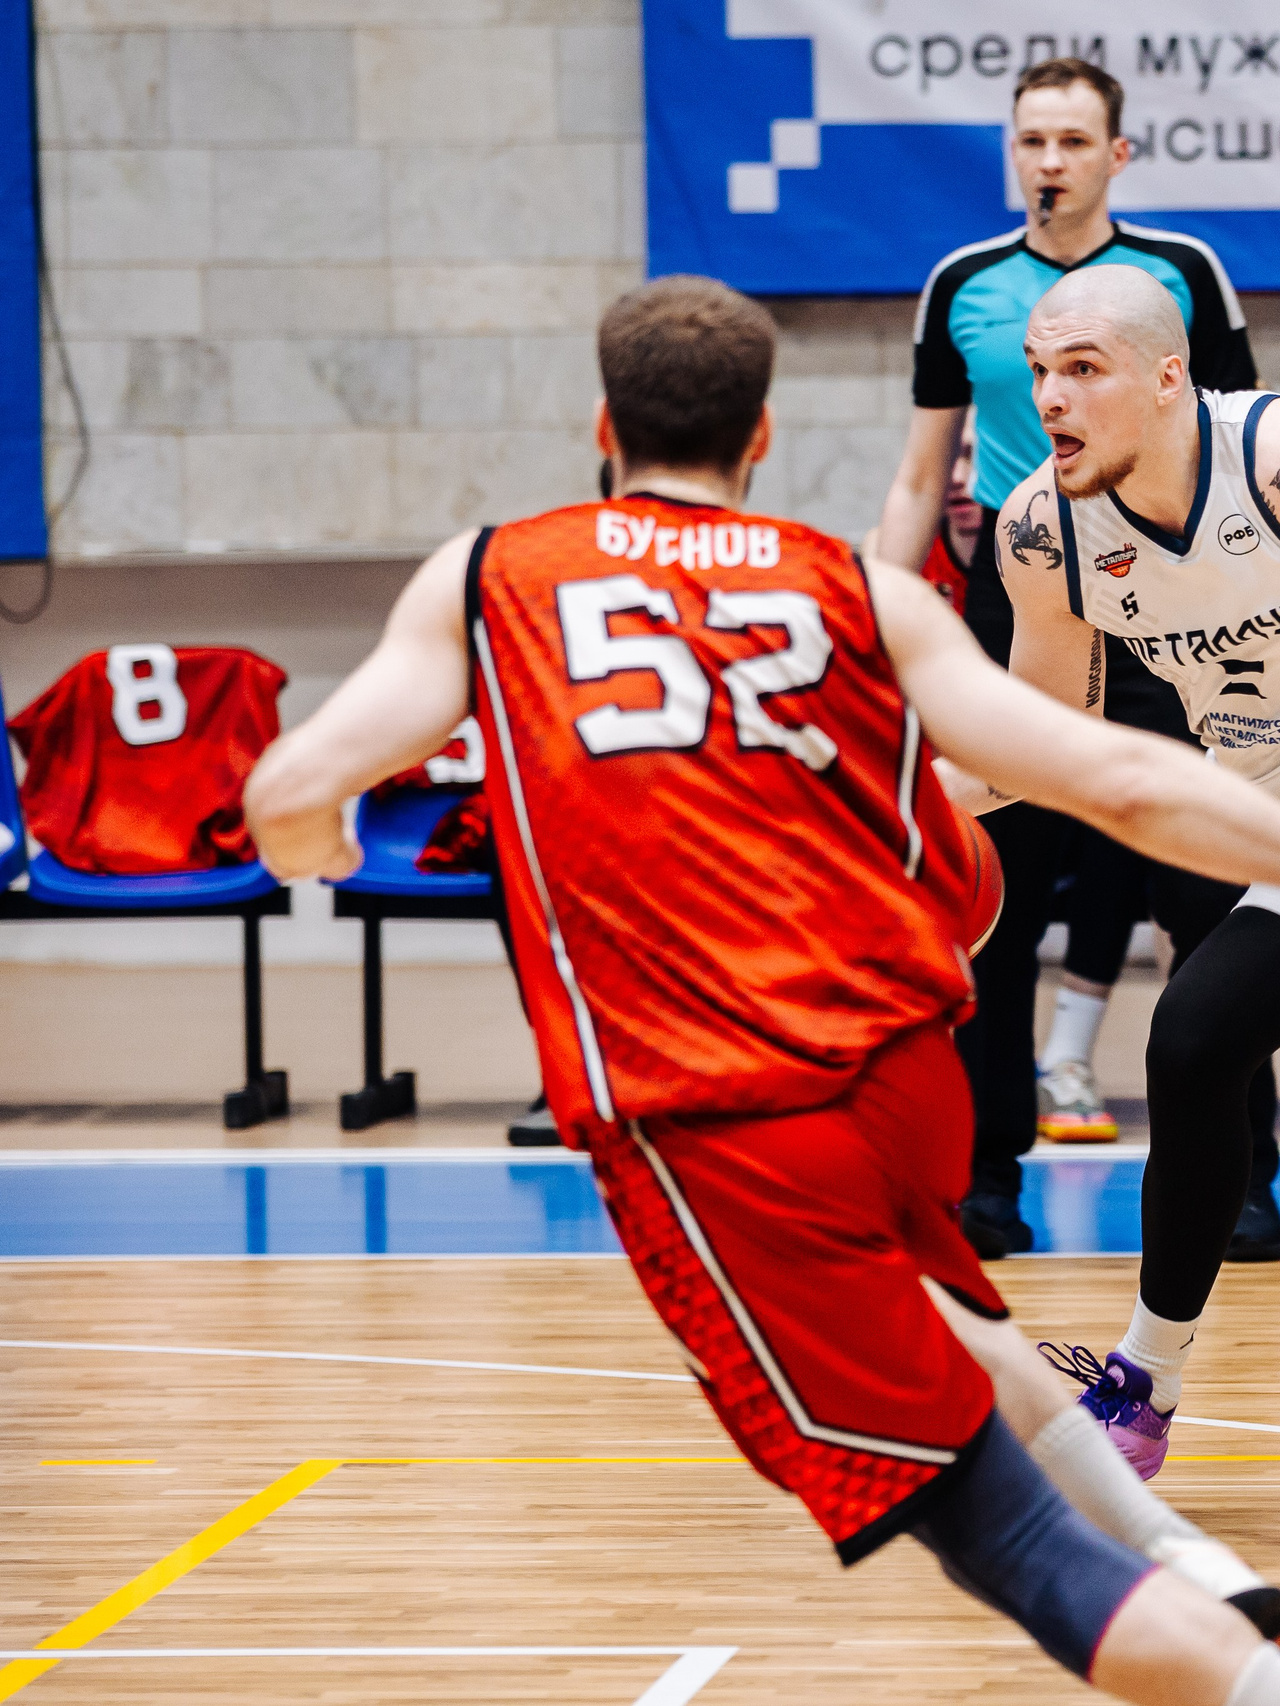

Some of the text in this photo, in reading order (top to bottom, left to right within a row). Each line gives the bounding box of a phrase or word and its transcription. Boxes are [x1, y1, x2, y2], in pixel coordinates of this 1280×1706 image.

[870, 33, 1106, 92] среди
[1095, 549, 1136, 569] МЕТАЛЛУРГ
[1223, 525, 1255, 546] РФБ
[106, 642, 188, 745] 8
[556, 574, 839, 772] 52
